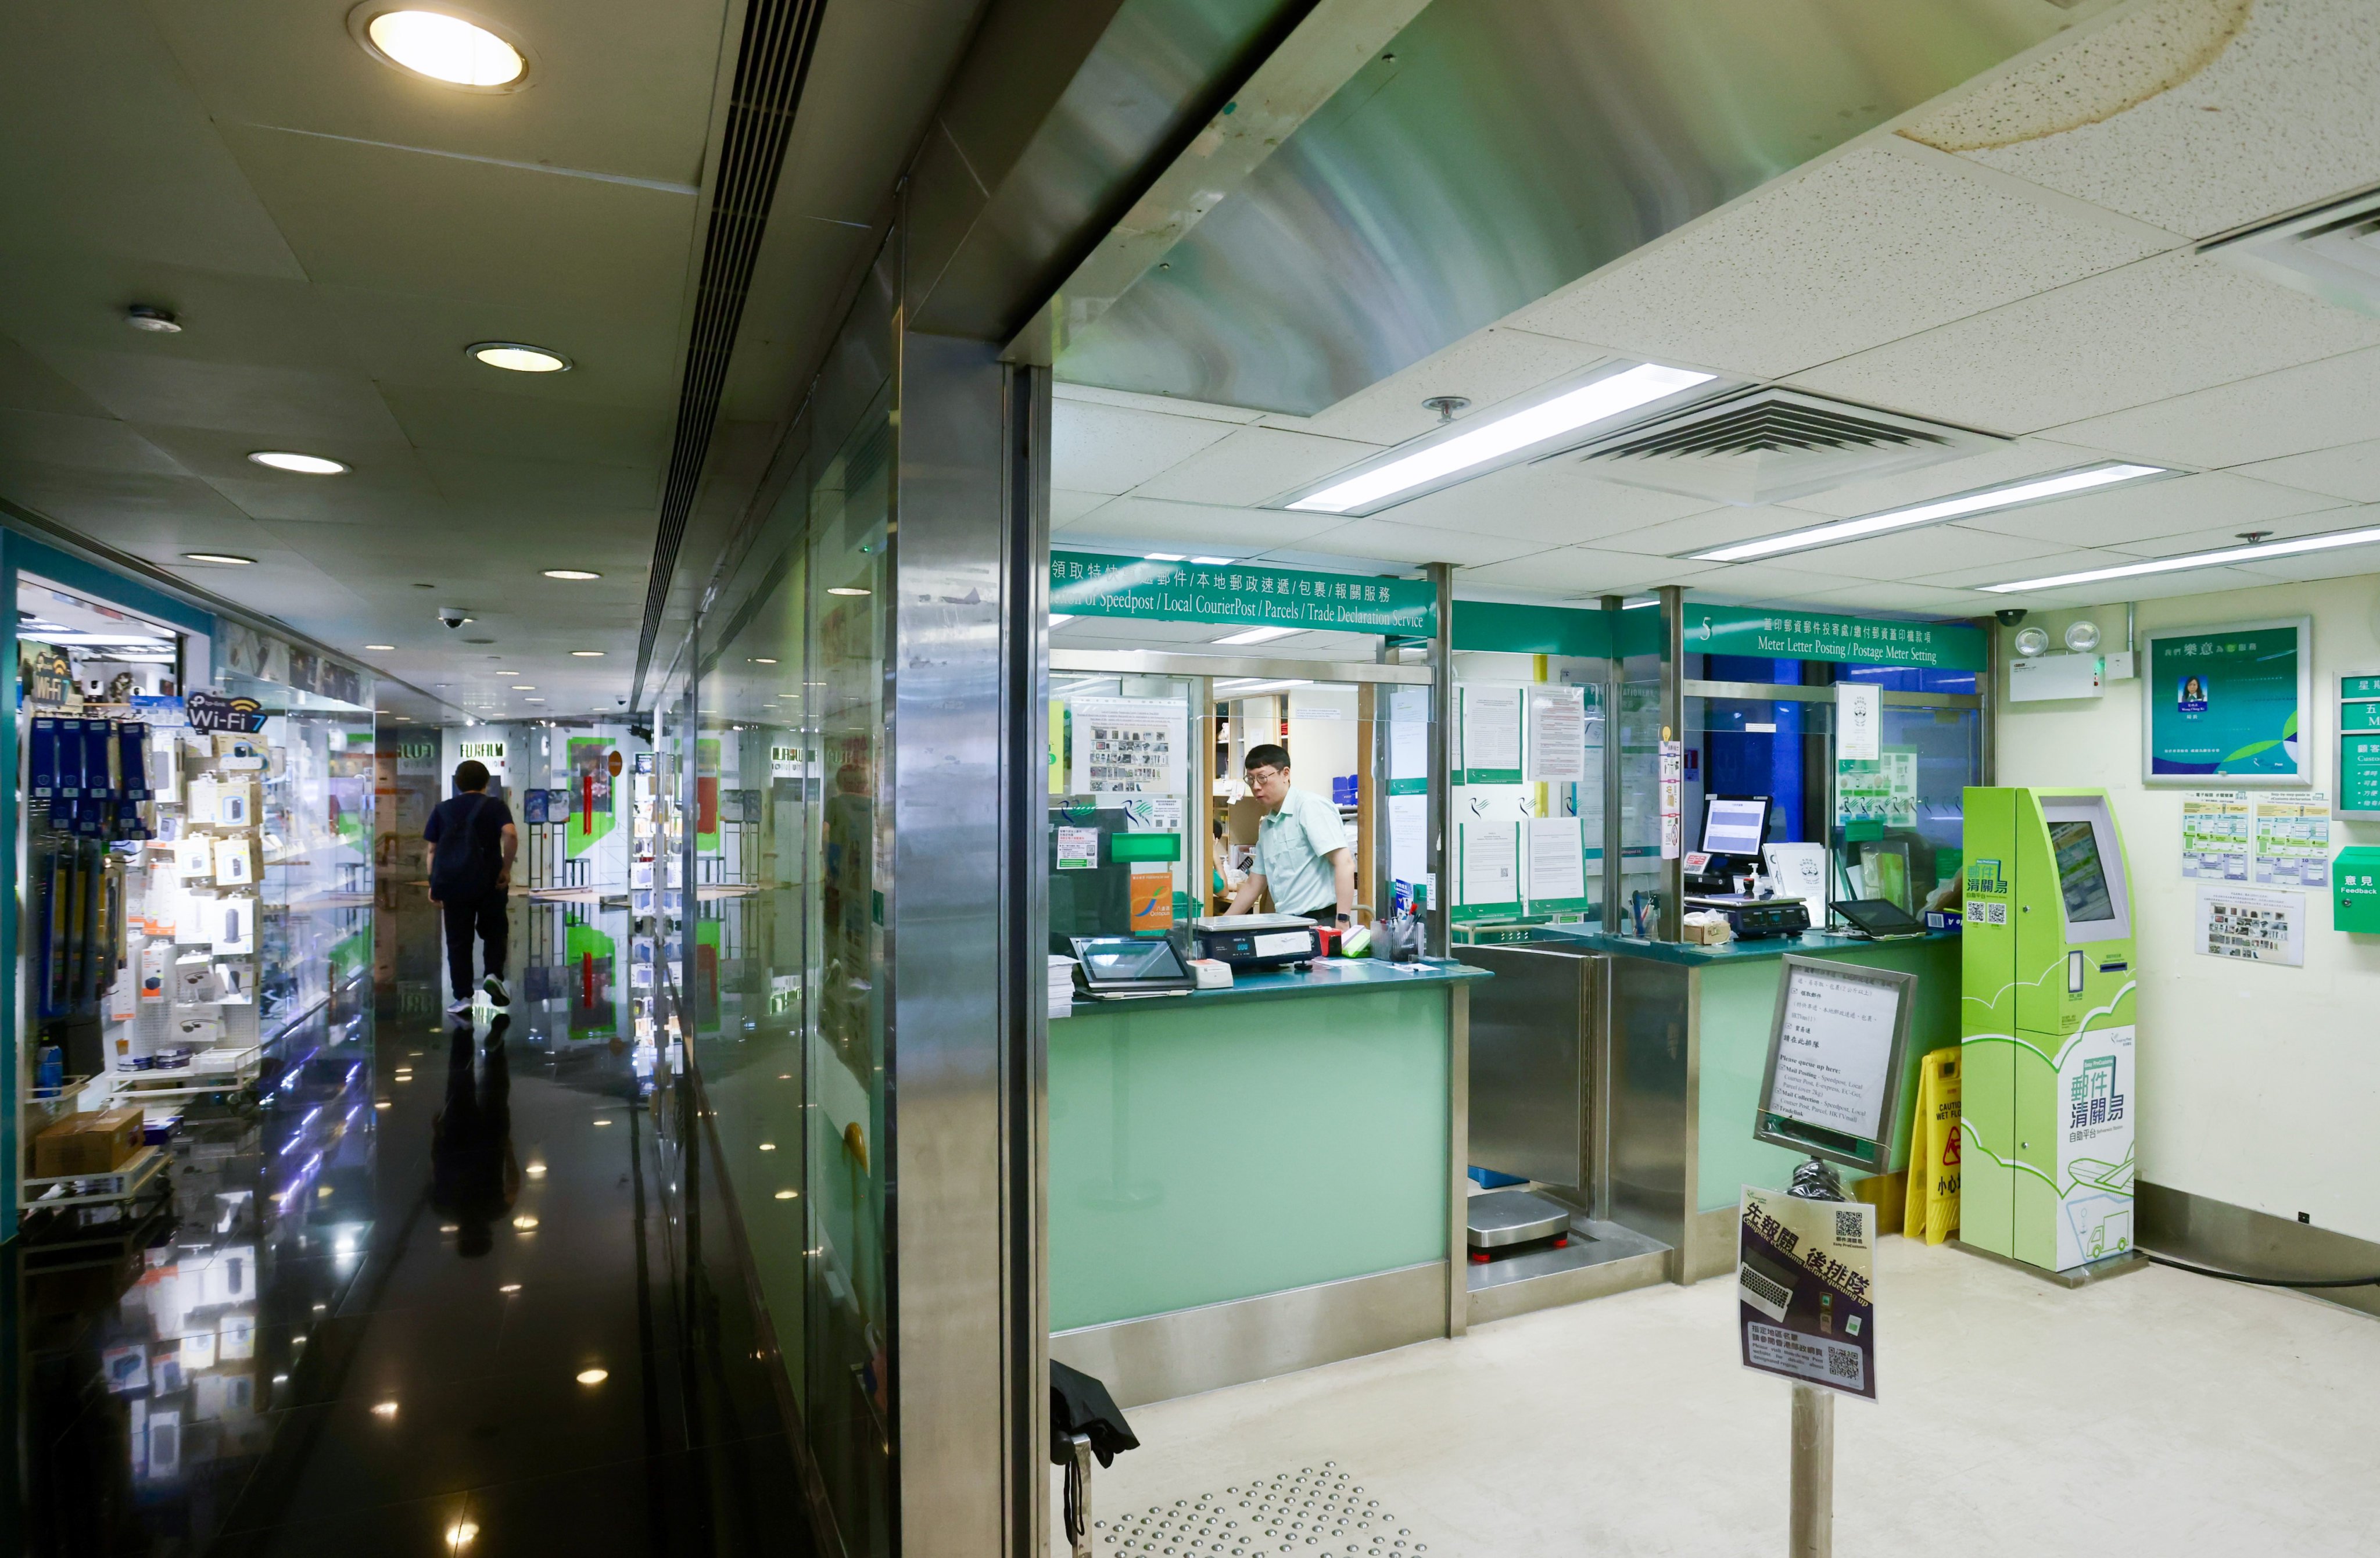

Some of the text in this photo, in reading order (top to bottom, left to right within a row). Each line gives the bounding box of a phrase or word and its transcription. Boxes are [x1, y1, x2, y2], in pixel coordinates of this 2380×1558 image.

[1100, 590, 1154, 613] Speedpost
[1157, 593, 1162, 610] /
[1164, 593, 1192, 612] Local
[1196, 594, 1256, 616] CourierPost
[1259, 599, 1263, 617] /
[1266, 600, 1299, 619] Parcels
[1301, 603, 1306, 619] /
[1307, 603, 1335, 622] Trade
[1338, 606, 1390, 626] Declaration
[1393, 610, 1424, 628] Service
[1700, 617, 1711, 640] 5
[1758, 636, 1937, 665] Meter Letter Posting / Postage Meter Setting
[2365, 704, 2377, 714] 五
[189, 709, 266, 731] Wi-Fi 7
[460, 743, 503, 758] FUJIFILM
[1967, 879, 2008, 894] 清關易
[2345, 875, 2373, 886] 意見
[1783, 1034, 1820, 1048] 請在此排隊
[1780, 1054, 1797, 1063] Please
[1798, 1060, 1815, 1069] queue
[1826, 1065, 1841, 1074] here:
[1783, 1082, 1797, 1091] Parcel
[1784, 1074, 1802, 1083] Courier
[1798, 1069, 1817, 1079] Posting
[1848, 1080, 1863, 1090] Local
[2071, 1071, 2107, 1101] 郵件
[1779, 1106, 1804, 1117] Tradelink
[1780, 1098, 1798, 1108] Courier
[1782, 1090, 1793, 1098] Mail
[1794, 1093, 1819, 1104] Collection
[1851, 1108, 1866, 1116] Local
[2070, 1094, 2124, 1129] 清關易
[1936, 1112, 1948, 1120] WET
[2070, 1129, 2096, 1142] 自助平台
[1744, 1202, 1870, 1296] 先報關 後排隊
[1770, 1240, 1803, 1265] eCustoms
[1803, 1260, 1827, 1281] before
[1827, 1277, 1858, 1302] queuing
[1858, 1298, 1869, 1307] up
